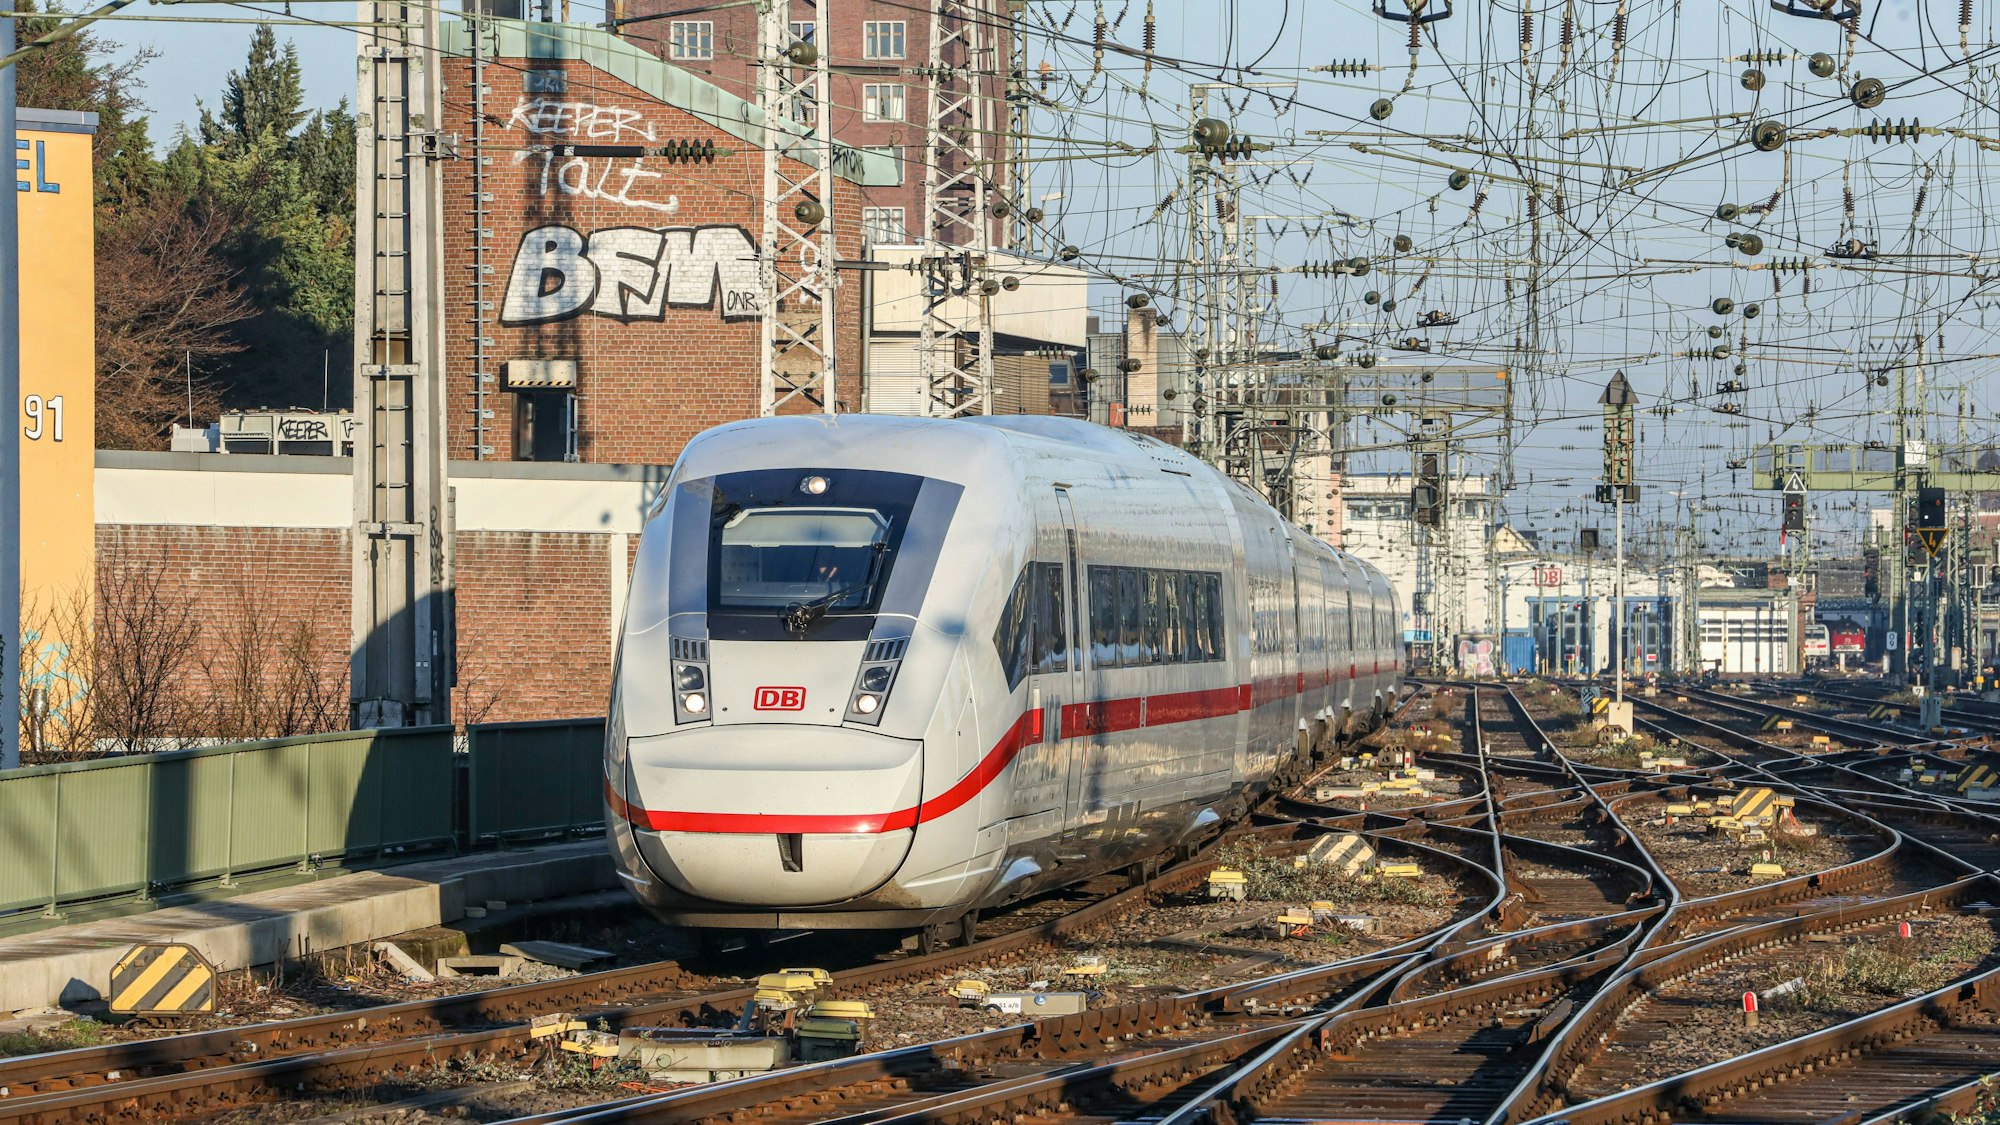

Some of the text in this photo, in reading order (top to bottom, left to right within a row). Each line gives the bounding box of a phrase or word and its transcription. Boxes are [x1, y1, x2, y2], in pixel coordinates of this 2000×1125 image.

[24, 394, 63, 442] 91
[278, 416, 328, 440] KEEPER
[1929, 532, 1936, 548] 4
[760, 690, 799, 707] DB
